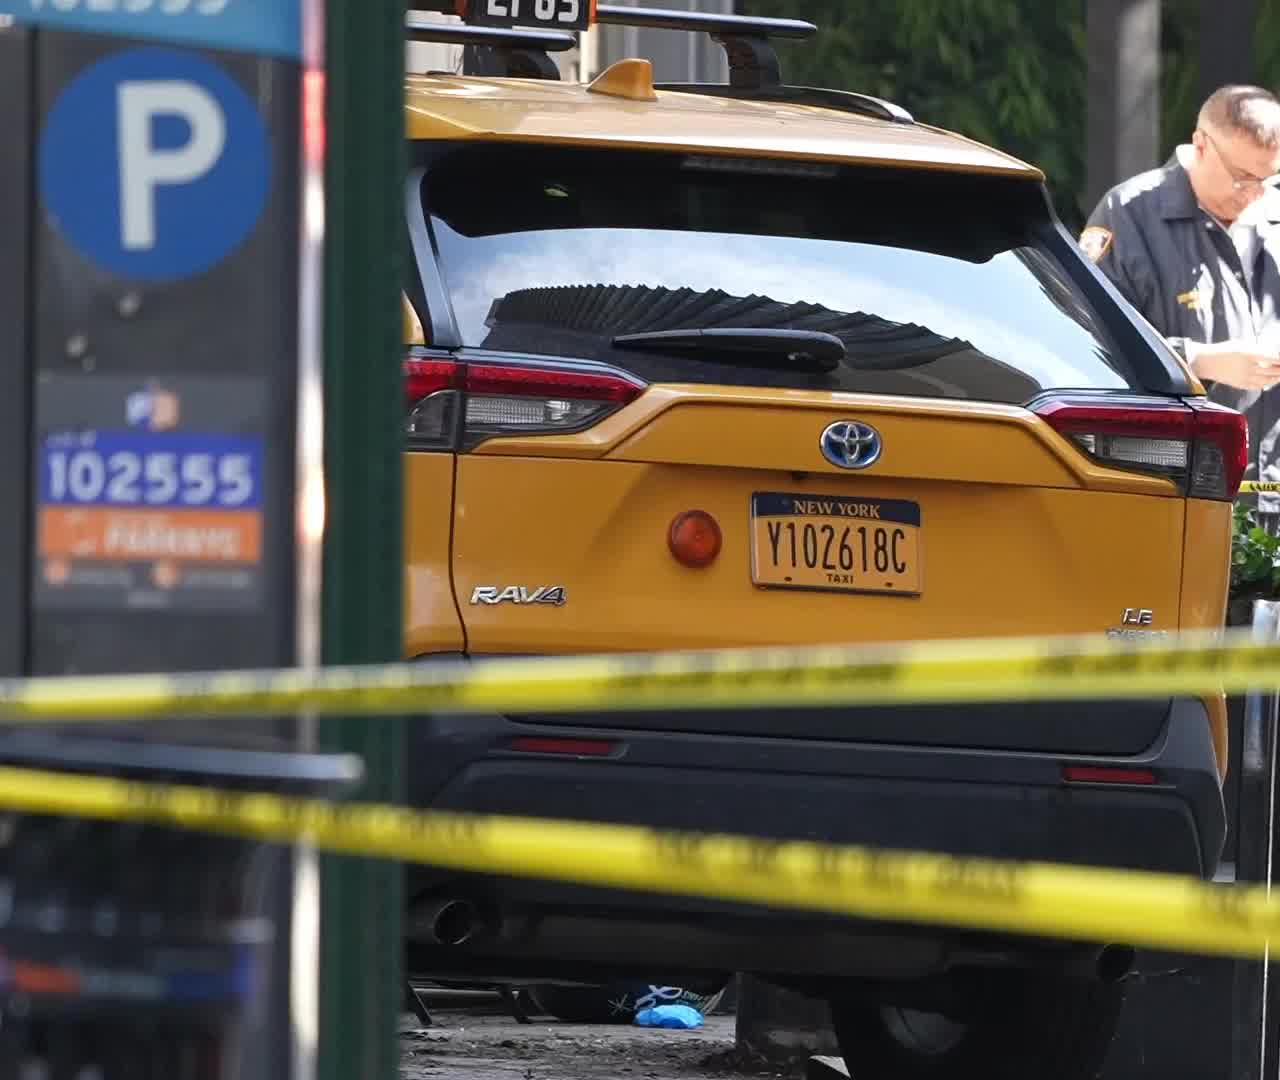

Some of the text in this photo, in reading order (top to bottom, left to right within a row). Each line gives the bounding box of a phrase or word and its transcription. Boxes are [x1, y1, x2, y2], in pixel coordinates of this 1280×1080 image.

[116, 80, 227, 251] P
[48, 450, 253, 506] 102555
[793, 500, 881, 519] NEW YORK
[768, 521, 906, 574] Y102618C
[826, 573, 855, 585] TAXI
[470, 586, 567, 606] RAV4
[1123, 608, 1153, 624] LE
